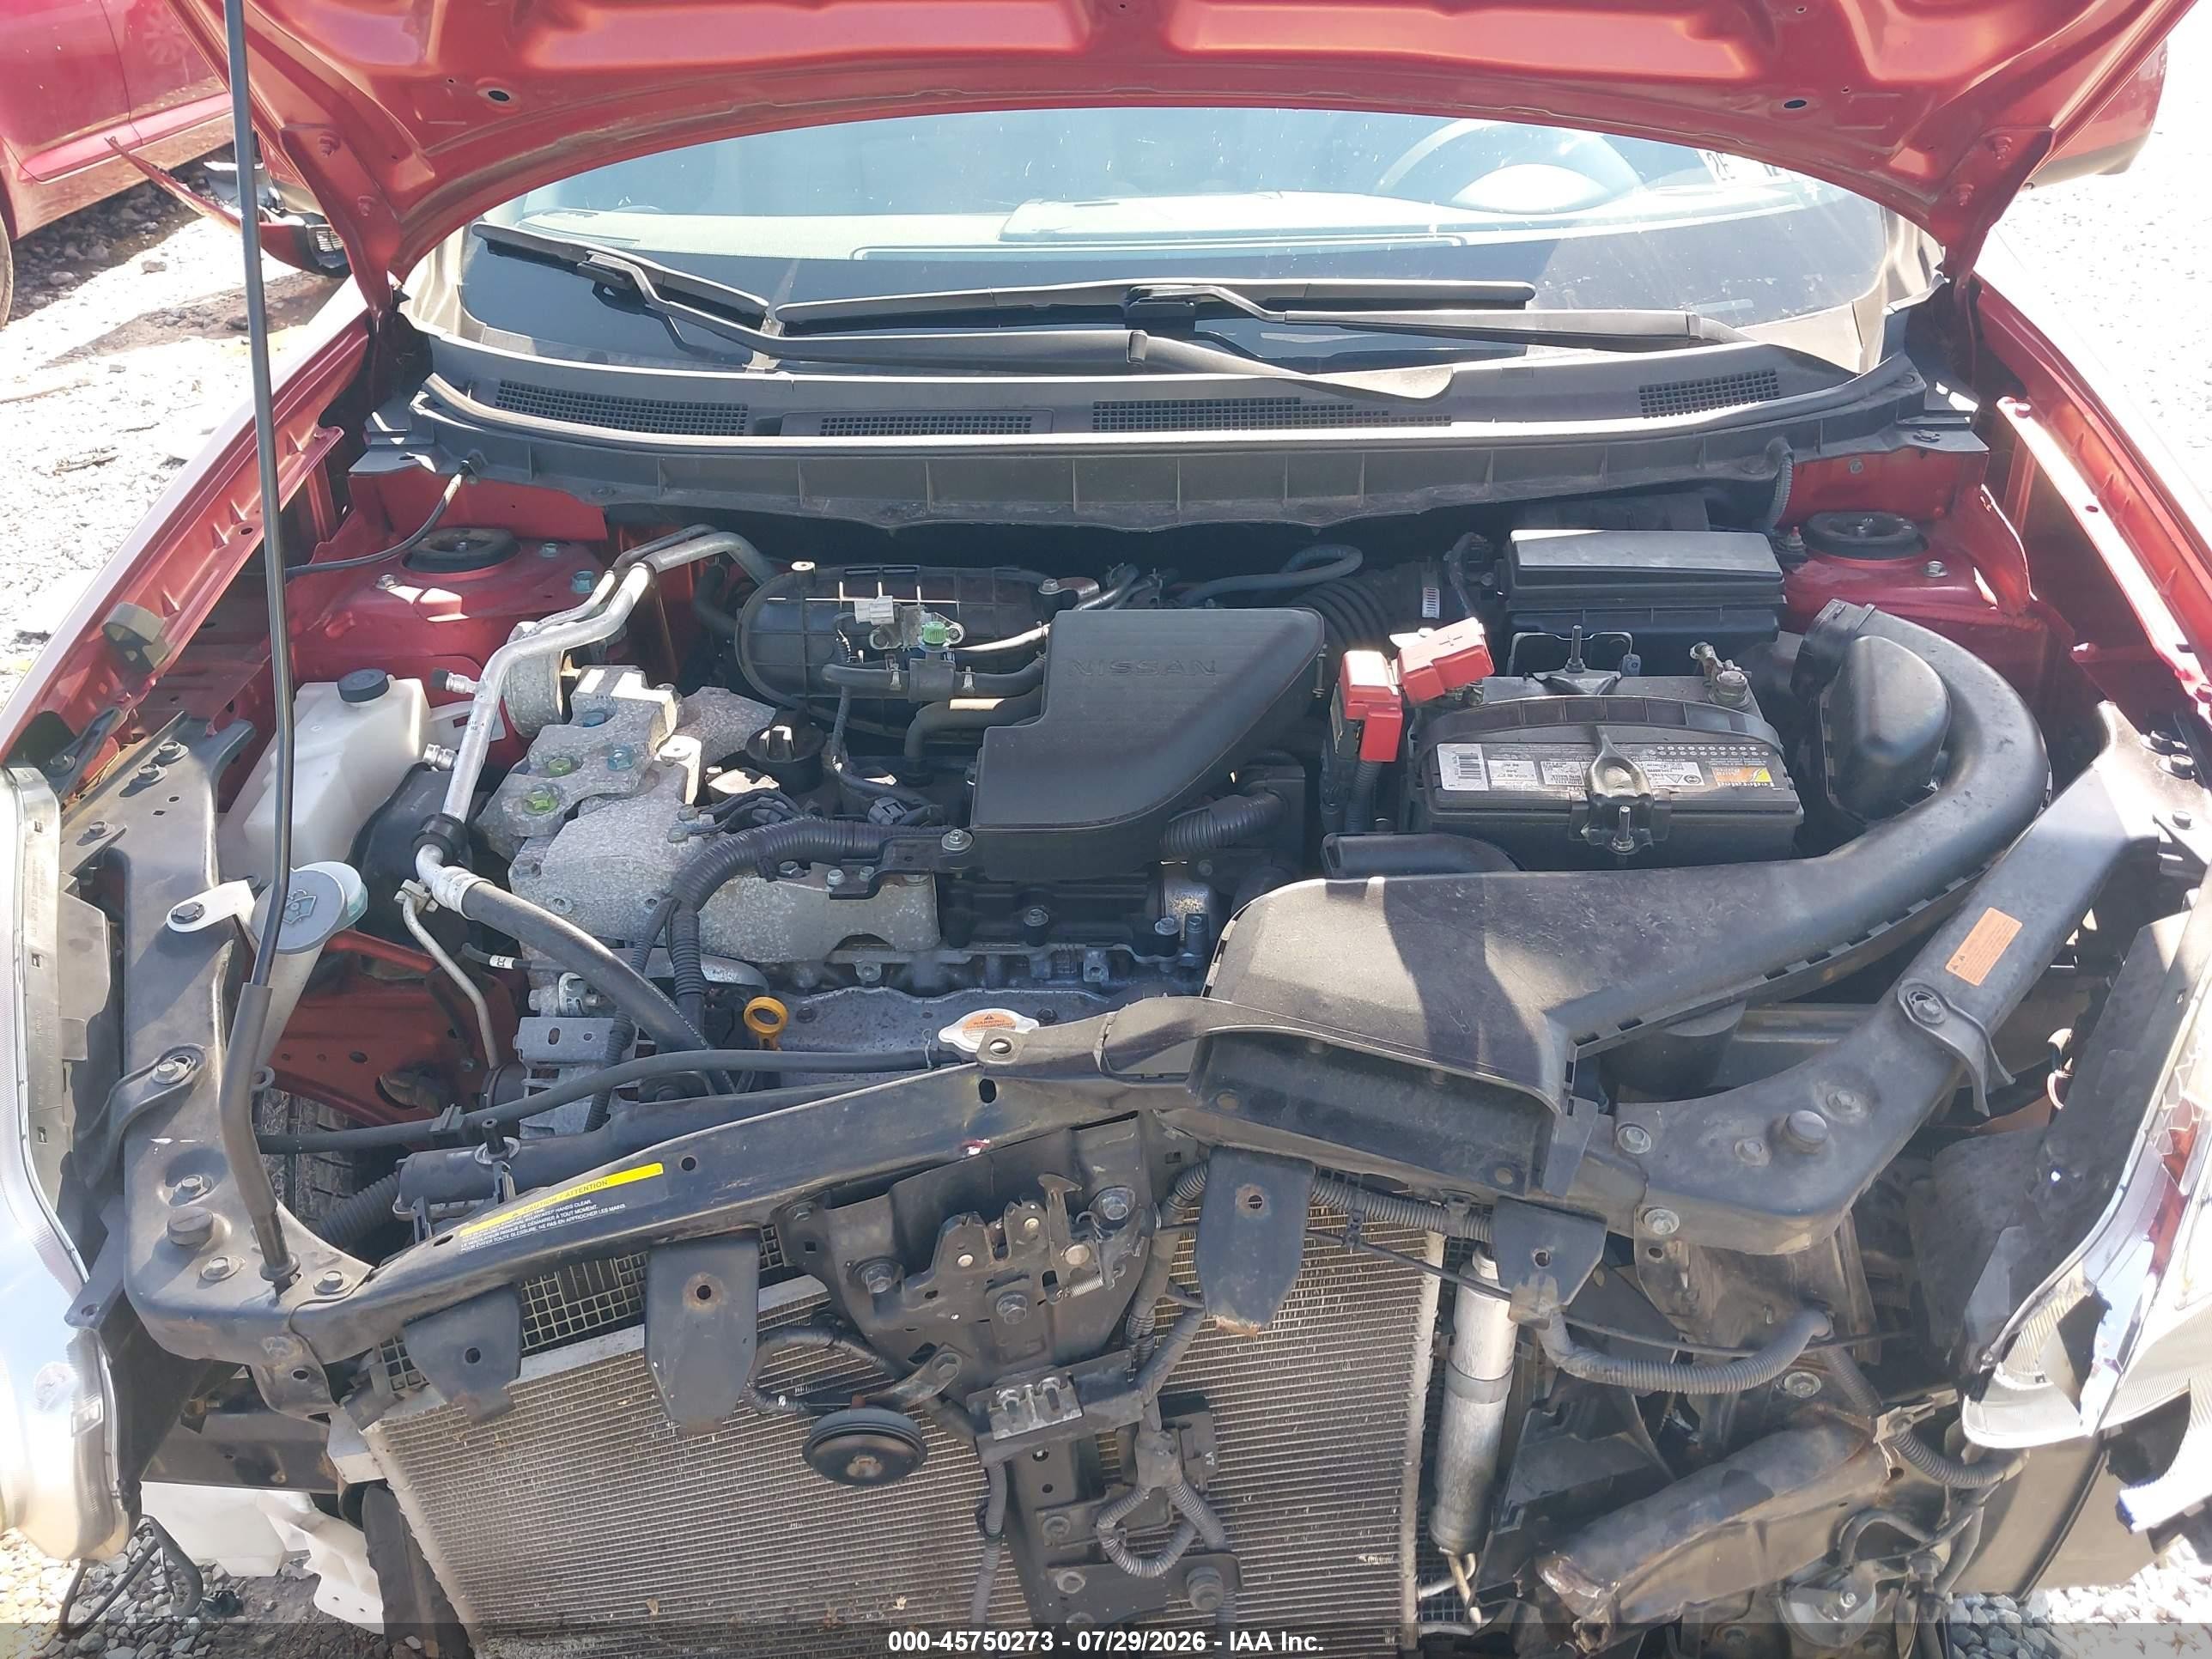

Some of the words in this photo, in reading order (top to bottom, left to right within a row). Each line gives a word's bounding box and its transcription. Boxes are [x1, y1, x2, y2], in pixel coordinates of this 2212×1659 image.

[1069, 659, 1217, 676] NISSAN
[565, 1180, 608, 1197] ATTENTION
[555, 1203, 574, 1212] HANDS
